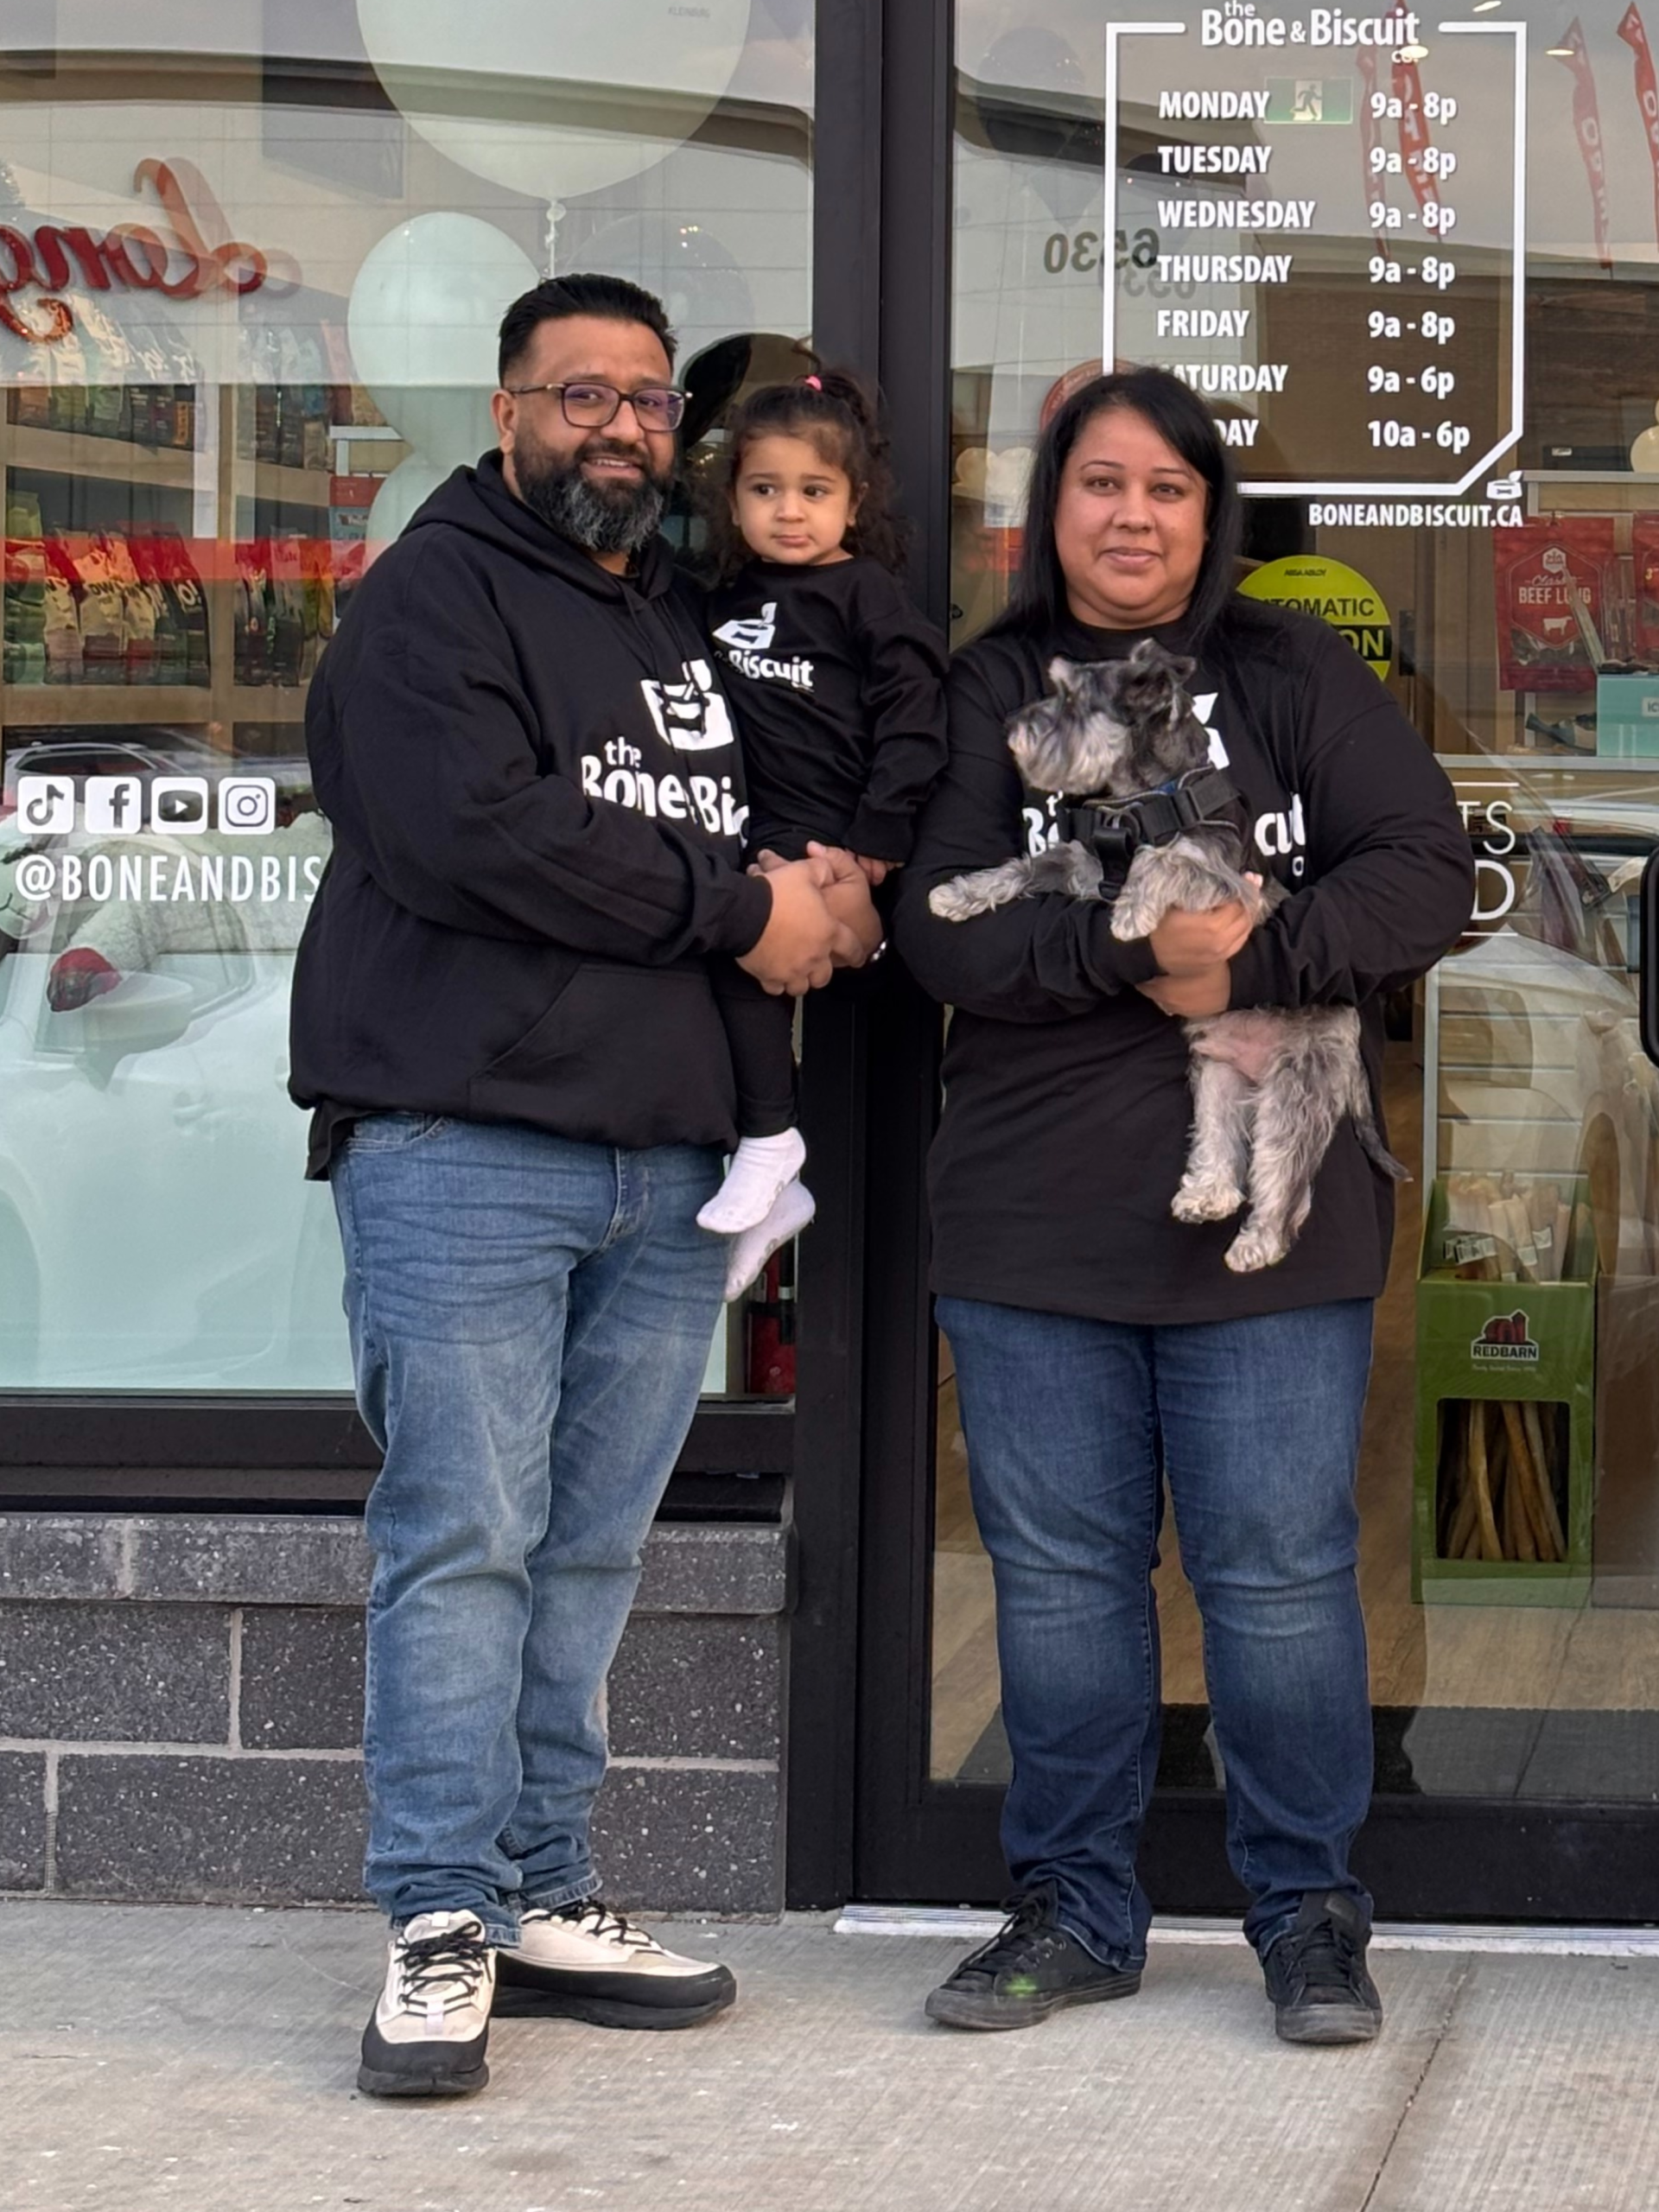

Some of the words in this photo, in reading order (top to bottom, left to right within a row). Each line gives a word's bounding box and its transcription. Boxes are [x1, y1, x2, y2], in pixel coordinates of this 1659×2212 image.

[1224, 0, 1255, 16] the
[1202, 9, 1286, 45] Bone
[1290, 21, 1306, 43] &
[1310, 8, 1420, 45] Biscuit
[1159, 91, 1270, 118] MONDAY
[1370, 92, 1402, 118] 9a
[1423, 92, 1457, 125] 8p
[1158, 146, 1272, 173] TUESDAY
[1370, 147, 1402, 174] 9a
[1423, 147, 1456, 180] 8p
[1158, 200, 1316, 228] WEDNESDAY
[1370, 201, 1402, 228] 9a
[1422, 201, 1456, 235] 8p
[1156, 255, 1293, 283] THURSDAY
[1369, 257, 1401, 283] 9a
[1422, 257, 1455, 289] 8p
[1157, 309, 1249, 337] FRIDAY
[1368, 311, 1401, 338] 9a
[1421, 311, 1455, 344] 8p
[1161, 364, 1288, 391] ATURDAY
[1368, 365, 1400, 392] 9a
[1421, 365, 1454, 399] 6p
[1368, 421, 1415, 447] 10a
[1436, 421, 1470, 454] 6p
[1308, 504, 1523, 527] BONEANDBISCUIT.CA
[1518, 588, 1552, 604] BEEF
[605, 737, 641, 766] the
[1473, 1345, 1537, 1358] REDBARN
